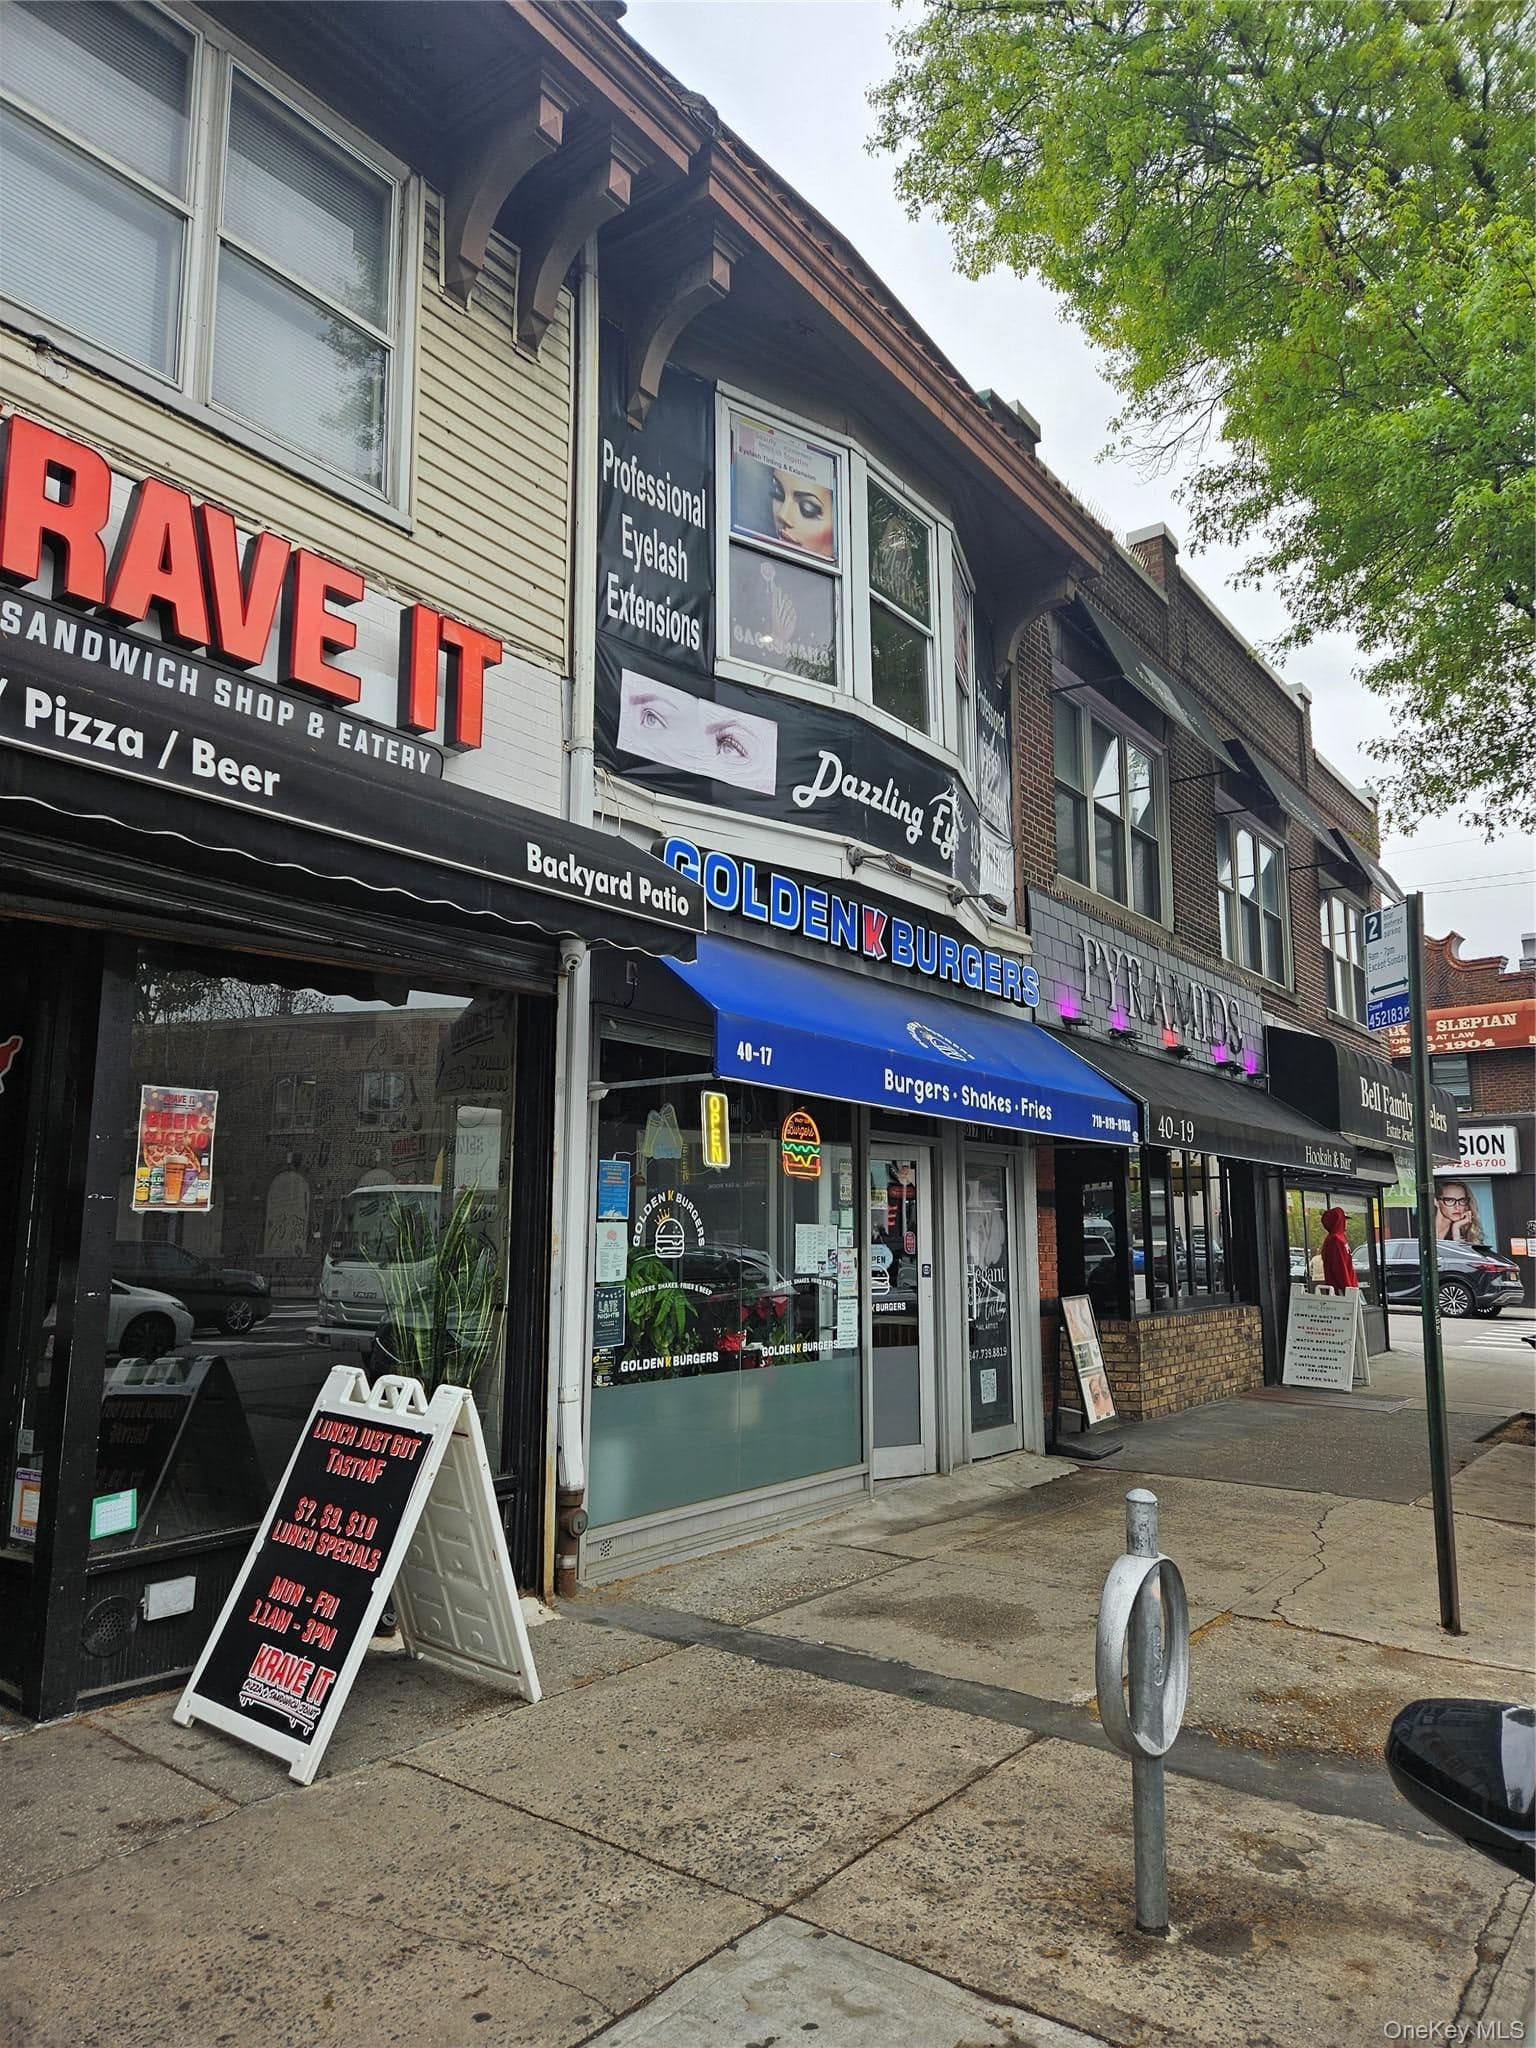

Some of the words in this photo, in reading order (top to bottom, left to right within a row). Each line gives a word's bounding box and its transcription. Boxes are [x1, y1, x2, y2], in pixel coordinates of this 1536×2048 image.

[602, 438, 706, 529] Professional
[621, 513, 688, 583] Eyelash
[0, 413, 365, 706] RAVE
[400, 602, 503, 751] IT
[607, 571, 700, 651] Extensions
[0, 600, 199, 697] SANDWICH
[214, 678, 295, 726] SHOP
[307, 712, 325, 739] &
[338, 722, 431, 774] EATERY
[25, 686, 144, 760] Pizza
[192, 737, 281, 797] Beer
[792, 750, 924, 844] Dazzling
[526, 841, 633, 901] Backyard
[639, 876, 690, 917] Patio
[1368, 916, 1379, 941] 2
[892, 918, 1041, 1008] BURGERS
[1368, 960, 1387, 973] Except
[1387, 954, 1407, 967] Sunday
[1079, 933, 1243, 1054] PYRAMIDS
[1436, 1013, 1518, 1032] SLEPIAN
[1437, 1033, 1448, 1041] AT
[1452, 1031, 1475, 1039] LAW
[737, 1041, 772, 1066] 40-17
[884, 1068, 950, 1104] Burgers
[961, 1085, 1011, 1114] Shakes
[1021, 1097, 1053, 1121] Fries
[1360, 1076, 1382, 1112] Bell
[1382, 1085, 1414, 1126] Family
[146, 1110, 198, 1130] BEER
[708, 1095, 723, 1164] OPEN
[1158, 1114, 1195, 1143] 40-19
[1305, 1145, 1332, 1168] Hookah
[1333, 1151, 1340, 1168] &
[1340, 1152, 1351, 1170] Bar
[1459, 1133, 1505, 1156] SION
[632, 1191, 666, 1247] GOLDEN
[667, 1189, 675, 1201] K
[676, 1193, 705, 1247] BURGERS
[876, 1302, 906, 1312] BURGERS
[620, 1356, 664, 1372] GOLDEN
[664, 1355, 672, 1368] K
[673, 1351, 719, 1367] BURGERS
[762, 1343, 796, 1357] GOLDEN
[802, 1339, 839, 1353] BURGERS
[313, 1417, 358, 1443] LUNCH
[356, 1427, 392, 1454] JUST
[389, 1434, 421, 1460] GOT
[271, 1519, 318, 1552] LUNCH
[316, 1532, 382, 1572] SPECIALS
[345, 1510, 378, 1541] $10
[268, 1575, 305, 1608] MON
[313, 1590, 341, 1620] FRI
[249, 1599, 293, 1634] 11AM
[301, 1618, 338, 1651] 3PM
[306, 1666, 337, 1706] IT
